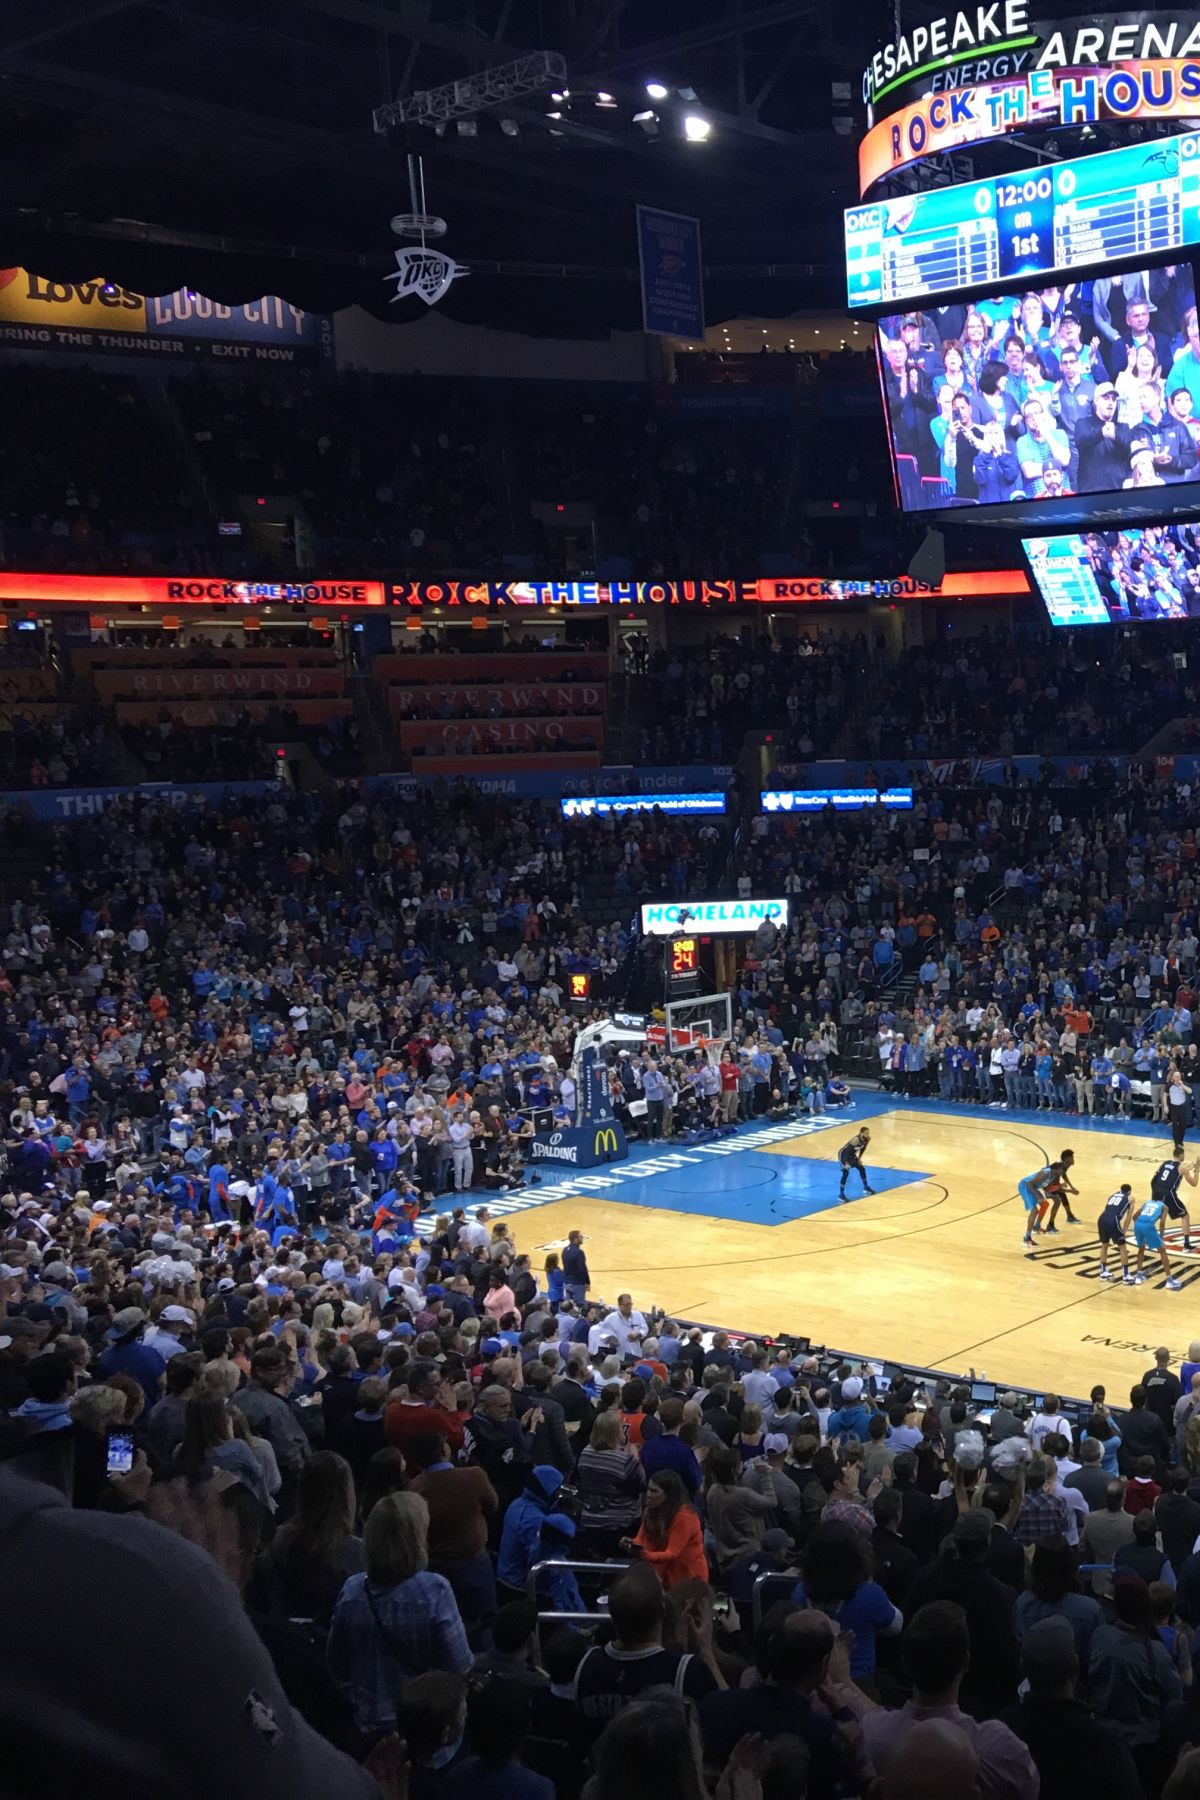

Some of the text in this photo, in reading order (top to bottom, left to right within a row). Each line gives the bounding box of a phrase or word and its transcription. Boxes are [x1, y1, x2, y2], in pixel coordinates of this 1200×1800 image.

[862, 0, 1029, 94] CHESAPEAKE
[931, 52, 1029, 94] ENERGY
[890, 88, 977, 161] ROCK
[984, 69, 1054, 129] THE
[996, 178, 1052, 207] 12:00
[1058, 169, 1076, 196] 0
[974, 187, 992, 214] 0
[846, 210, 880, 232] OKC
[1012, 233, 1040, 256] 1st
[56, 331, 93, 346] THE
[100, 335, 185, 353] THUNDER
[211, 344, 251, 359] EXIT
[255, 347, 295, 361] NOW
[168, 581, 367, 603] ROCK THE HOUSE
[385, 579, 759, 606] ROCK THE HOUSE
[774, 581, 834, 599] ROCK
[838, 580, 871, 595] THE
[134, 673, 312, 690] RIVERWIND
[442, 722, 565, 742] CASINO
[712, 767, 733, 777] 102
[1156, 756, 1174, 766] 104
[647, 902, 782, 924] HOMELAND
[673, 952, 693, 971] 24
[573, 985, 584, 995] 24
[532, 1142, 578, 1163] SPALDING
[610, 1153, 703, 1178] CITY
[687, 1114, 855, 1156] THUNDER
[1161, 1169, 1170, 1181] 9
[1141, 1206, 1156, 1217] 23
